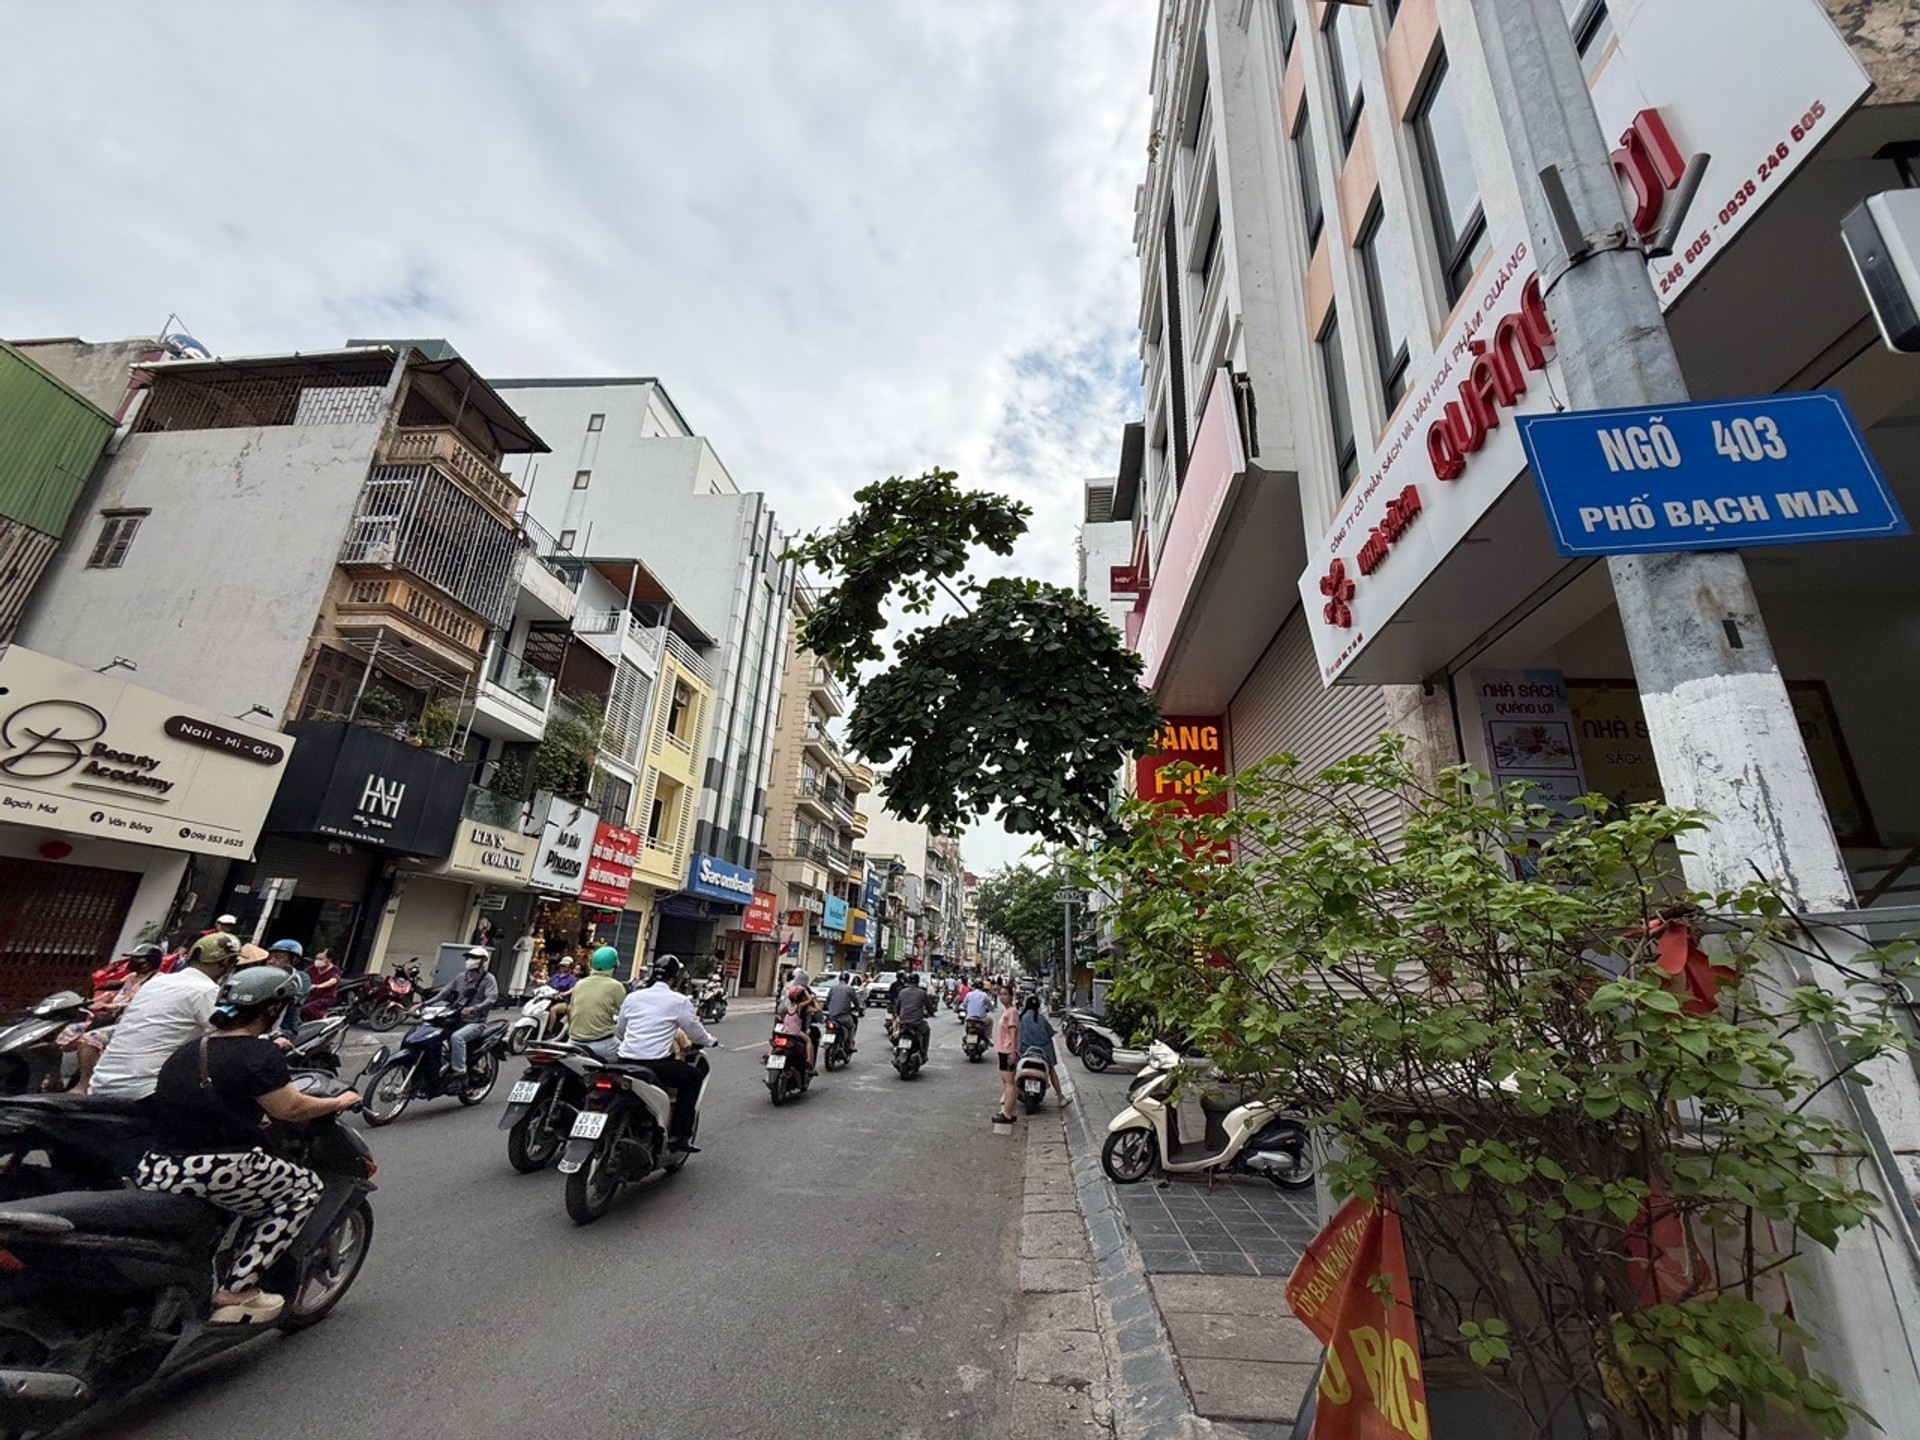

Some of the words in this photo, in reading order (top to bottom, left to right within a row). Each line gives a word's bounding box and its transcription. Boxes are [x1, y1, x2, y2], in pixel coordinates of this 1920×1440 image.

[1659, 262, 1685, 294] 246
[1684, 230, 1711, 264] 605
[1718, 179, 1757, 225] 0938
[1757, 142, 1789, 182] 246
[1790, 99, 1826, 142] 605
[1381, 438, 1402, 474] SÁCH
[1483, 241, 1527, 312] QUẢNG
[1597, 416, 1682, 473] NGÕ
[1711, 416, 1788, 463] 403
[1579, 493, 1656, 533] PHỐ
[1663, 495, 1769, 532] BẠCH
[1775, 488, 1859, 519] MAI
[1483, 680, 1515, 698] NHÀ
[1518, 681, 1562, 699] SÁCH
[1496, 701, 1536, 715] QUẢNG
[90, 742, 161, 772] Beauty
[180, 723, 213, 740] Nail
[225, 736, 242, 749] Mi
[253, 745, 275, 759] Gội
[82, 760, 175, 794] Academy
[3, 796, 33, 811] Bạch
[37, 803, 58, 815] Mai
[190, 831, 206, 841] 096
[207, 834, 222, 844] 553
[700, 859, 754, 896] Sacombank
